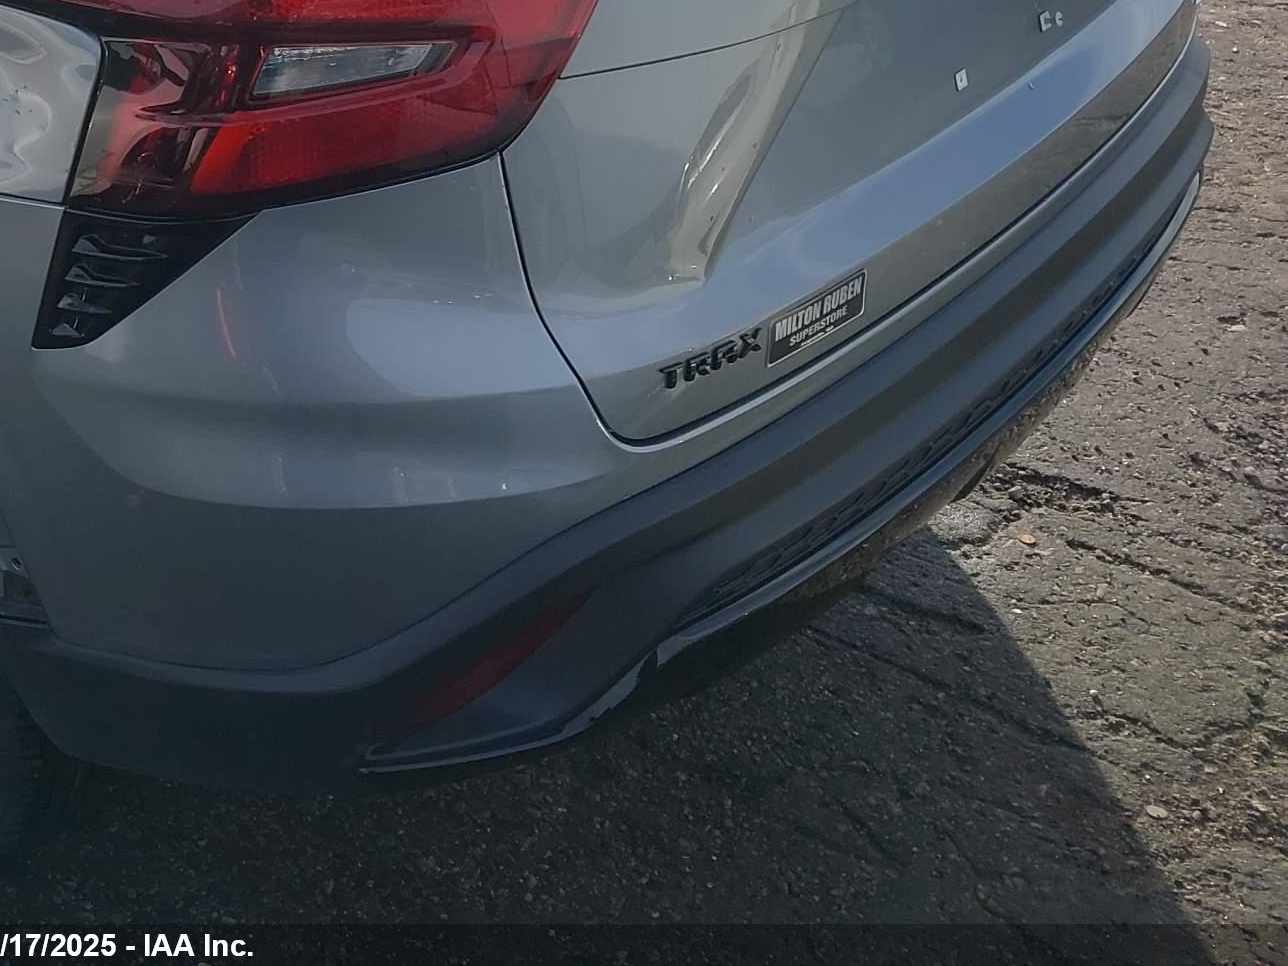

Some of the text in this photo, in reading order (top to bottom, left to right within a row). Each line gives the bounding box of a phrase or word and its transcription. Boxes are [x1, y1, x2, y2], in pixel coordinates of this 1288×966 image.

[775, 300, 822, 341] MILTON
[822, 276, 863, 315] RUBEN
[789, 305, 848, 346] SUPERSTORE
[659, 327, 762, 389] TRAX
